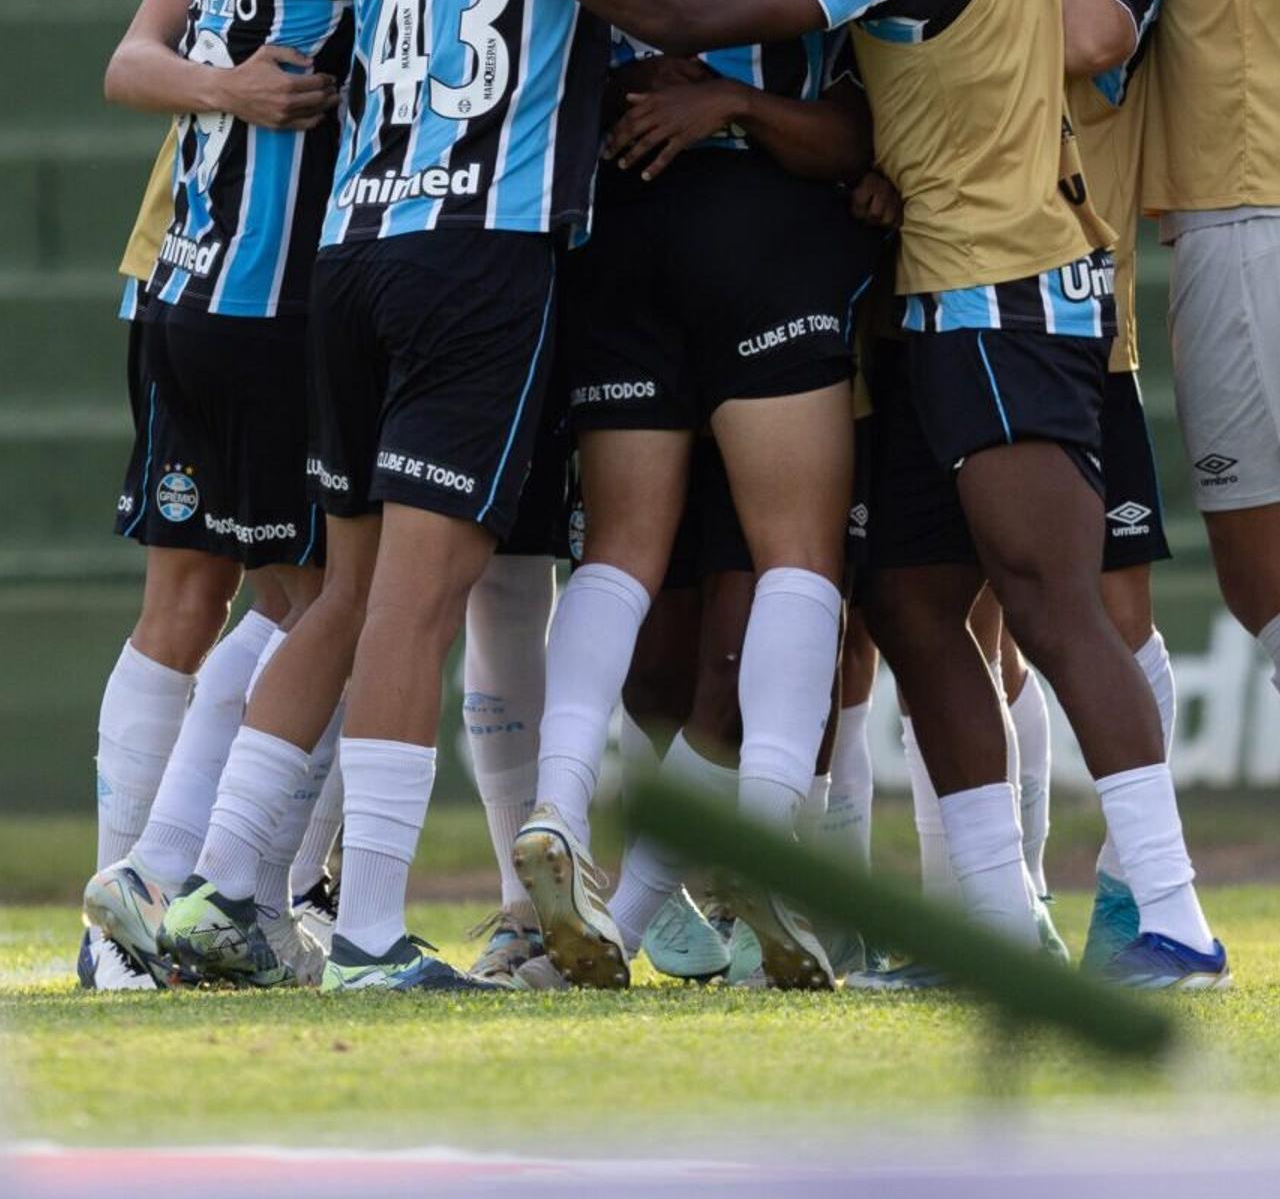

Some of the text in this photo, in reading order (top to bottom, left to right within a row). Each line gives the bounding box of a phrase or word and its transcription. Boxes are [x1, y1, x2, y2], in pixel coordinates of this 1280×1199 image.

[337, 162, 481, 208] Unimed
[160, 226, 221, 275] nimed
[738, 325, 787, 357] CLUBE
[788, 318, 806, 338] DE
[601, 381, 656, 400] TODOS
[404, 458, 424, 478] DE
[425, 464, 475, 494] TODOS
[1200, 475, 1238, 488] umbro
[248, 523, 297, 544] TODOS
[1112, 525, 1149, 537] umbro
